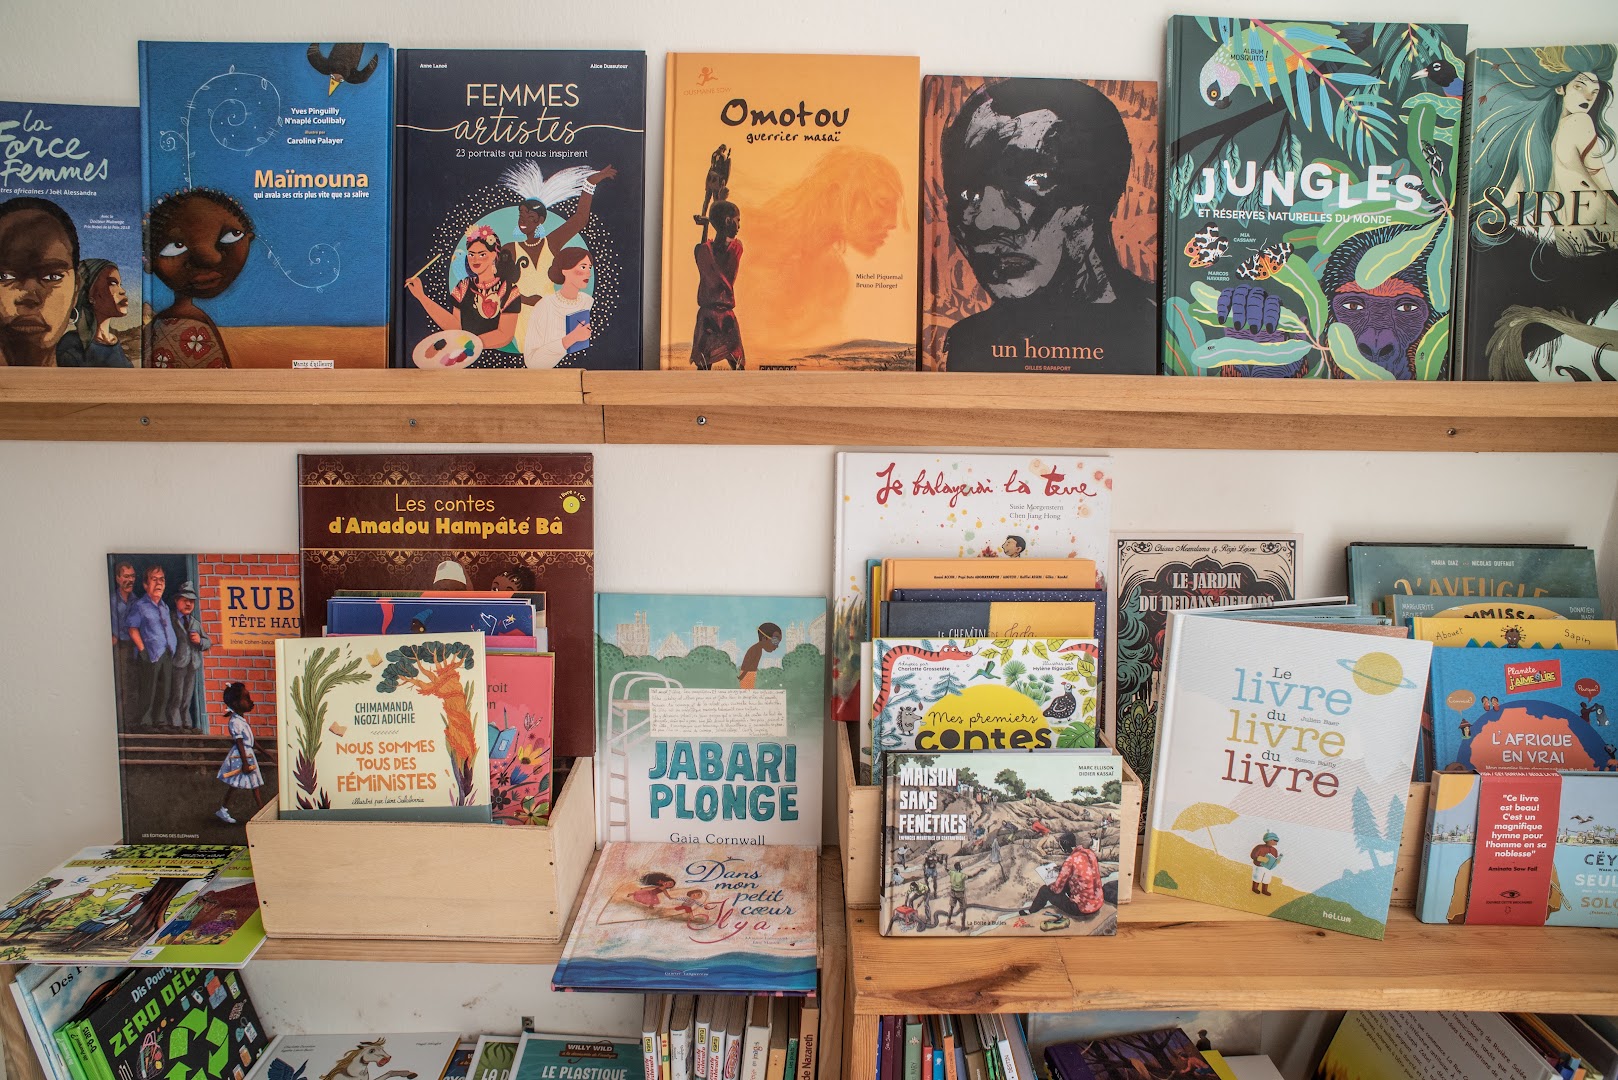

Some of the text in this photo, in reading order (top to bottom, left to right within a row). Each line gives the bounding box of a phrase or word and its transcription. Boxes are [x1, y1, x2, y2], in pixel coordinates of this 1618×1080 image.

[466, 83, 580, 107] FEMMES
[291, 107, 340, 116] Yves Pinguilly
[720, 98, 850, 127] Omotou
[285, 117, 346, 126] N'naplé Coulibaly
[454, 107, 577, 145] artistes
[0, 119, 90, 160] Force
[317, 138, 344, 146] Palayer
[746, 131, 841, 144] guerrier masaï
[456, 148, 588, 160] 23 portraits qui nous inspirent
[0, 158, 108, 187] Femmes
[254, 169, 369, 188] Maïmouna
[1193, 160, 1423, 211] JUNGLES
[253, 191, 264, 200] qui
[264, 191, 282, 199] avala
[293, 191, 303, 199] cris
[304, 191, 318, 200] plus
[331, 192, 343, 200] que
[352, 190, 370, 198] salive
[1198, 208, 1392, 224] ET RÉSERVES NATURELLES DU MONDE
[991, 338, 1105, 360] un homme
[875, 462, 904, 505] Je
[1004, 469, 1031, 495] la
[395, 493, 496, 513] Les contes
[1009, 503, 1025, 511] Susie
[1009, 512, 1062, 521] Chen Jiang Hong
[328, 516, 563, 539] d'Amadou Hampâté Bâ
[1172, 572, 1241, 591] LE JARDIN
[227, 586, 300, 611] RUB
[1139, 596, 1157, 612] DU
[229, 614, 266, 628] TÊTE
[1436, 627, 1591, 646] Abouet Sapin
[1272, 667, 1292, 680] Le
[1507, 666, 1537, 676] Planète
[1231, 667, 1353, 716] livre
[355, 701, 414, 713] CHIMAMANDA
[1267, 709, 1286, 722] du
[354, 712, 416, 725] NGOZI ADICHIE
[928, 711, 1038, 728] Mes premiers
[915, 728, 1052, 750] contes
[1226, 708, 1346, 758] livre
[336, 739, 436, 755] NOUS SOMMES
[356, 756, 417, 771] TOUS DES
[648, 740, 797, 783] JABARI
[1262, 750, 1281, 762] du
[1502, 750, 1565, 764] EN VRAI
[900, 767, 957, 787] MAISON
[1221, 749, 1340, 798] livre
[649, 784, 799, 822] PLONGE
[900, 790, 937, 810] SANS
[1520, 794, 1539, 802] livre
[1515, 804, 1540, 812] beau!
[899, 810, 967, 834] FENÊTRES
[1503, 813, 1523, 821] C'est
[1494, 823, 1543, 832] magnifique
[669, 832, 766, 846] Gaia Cornwall
[1485, 841, 1522, 849] l'homme
[1491, 832, 1544, 841] hymne pour
[685, 856, 763, 883] Dans
[714, 881, 759, 890] mon
[732, 889, 784, 906] petit
[49, 974, 74, 997] Des
[130, 984, 147, 1004] Dis
[109, 998, 161, 1058] ZÉRO
[803, 1034, 814, 1070] Nazareth
[542, 1065, 628, 1080] LE PLASTIQUE
